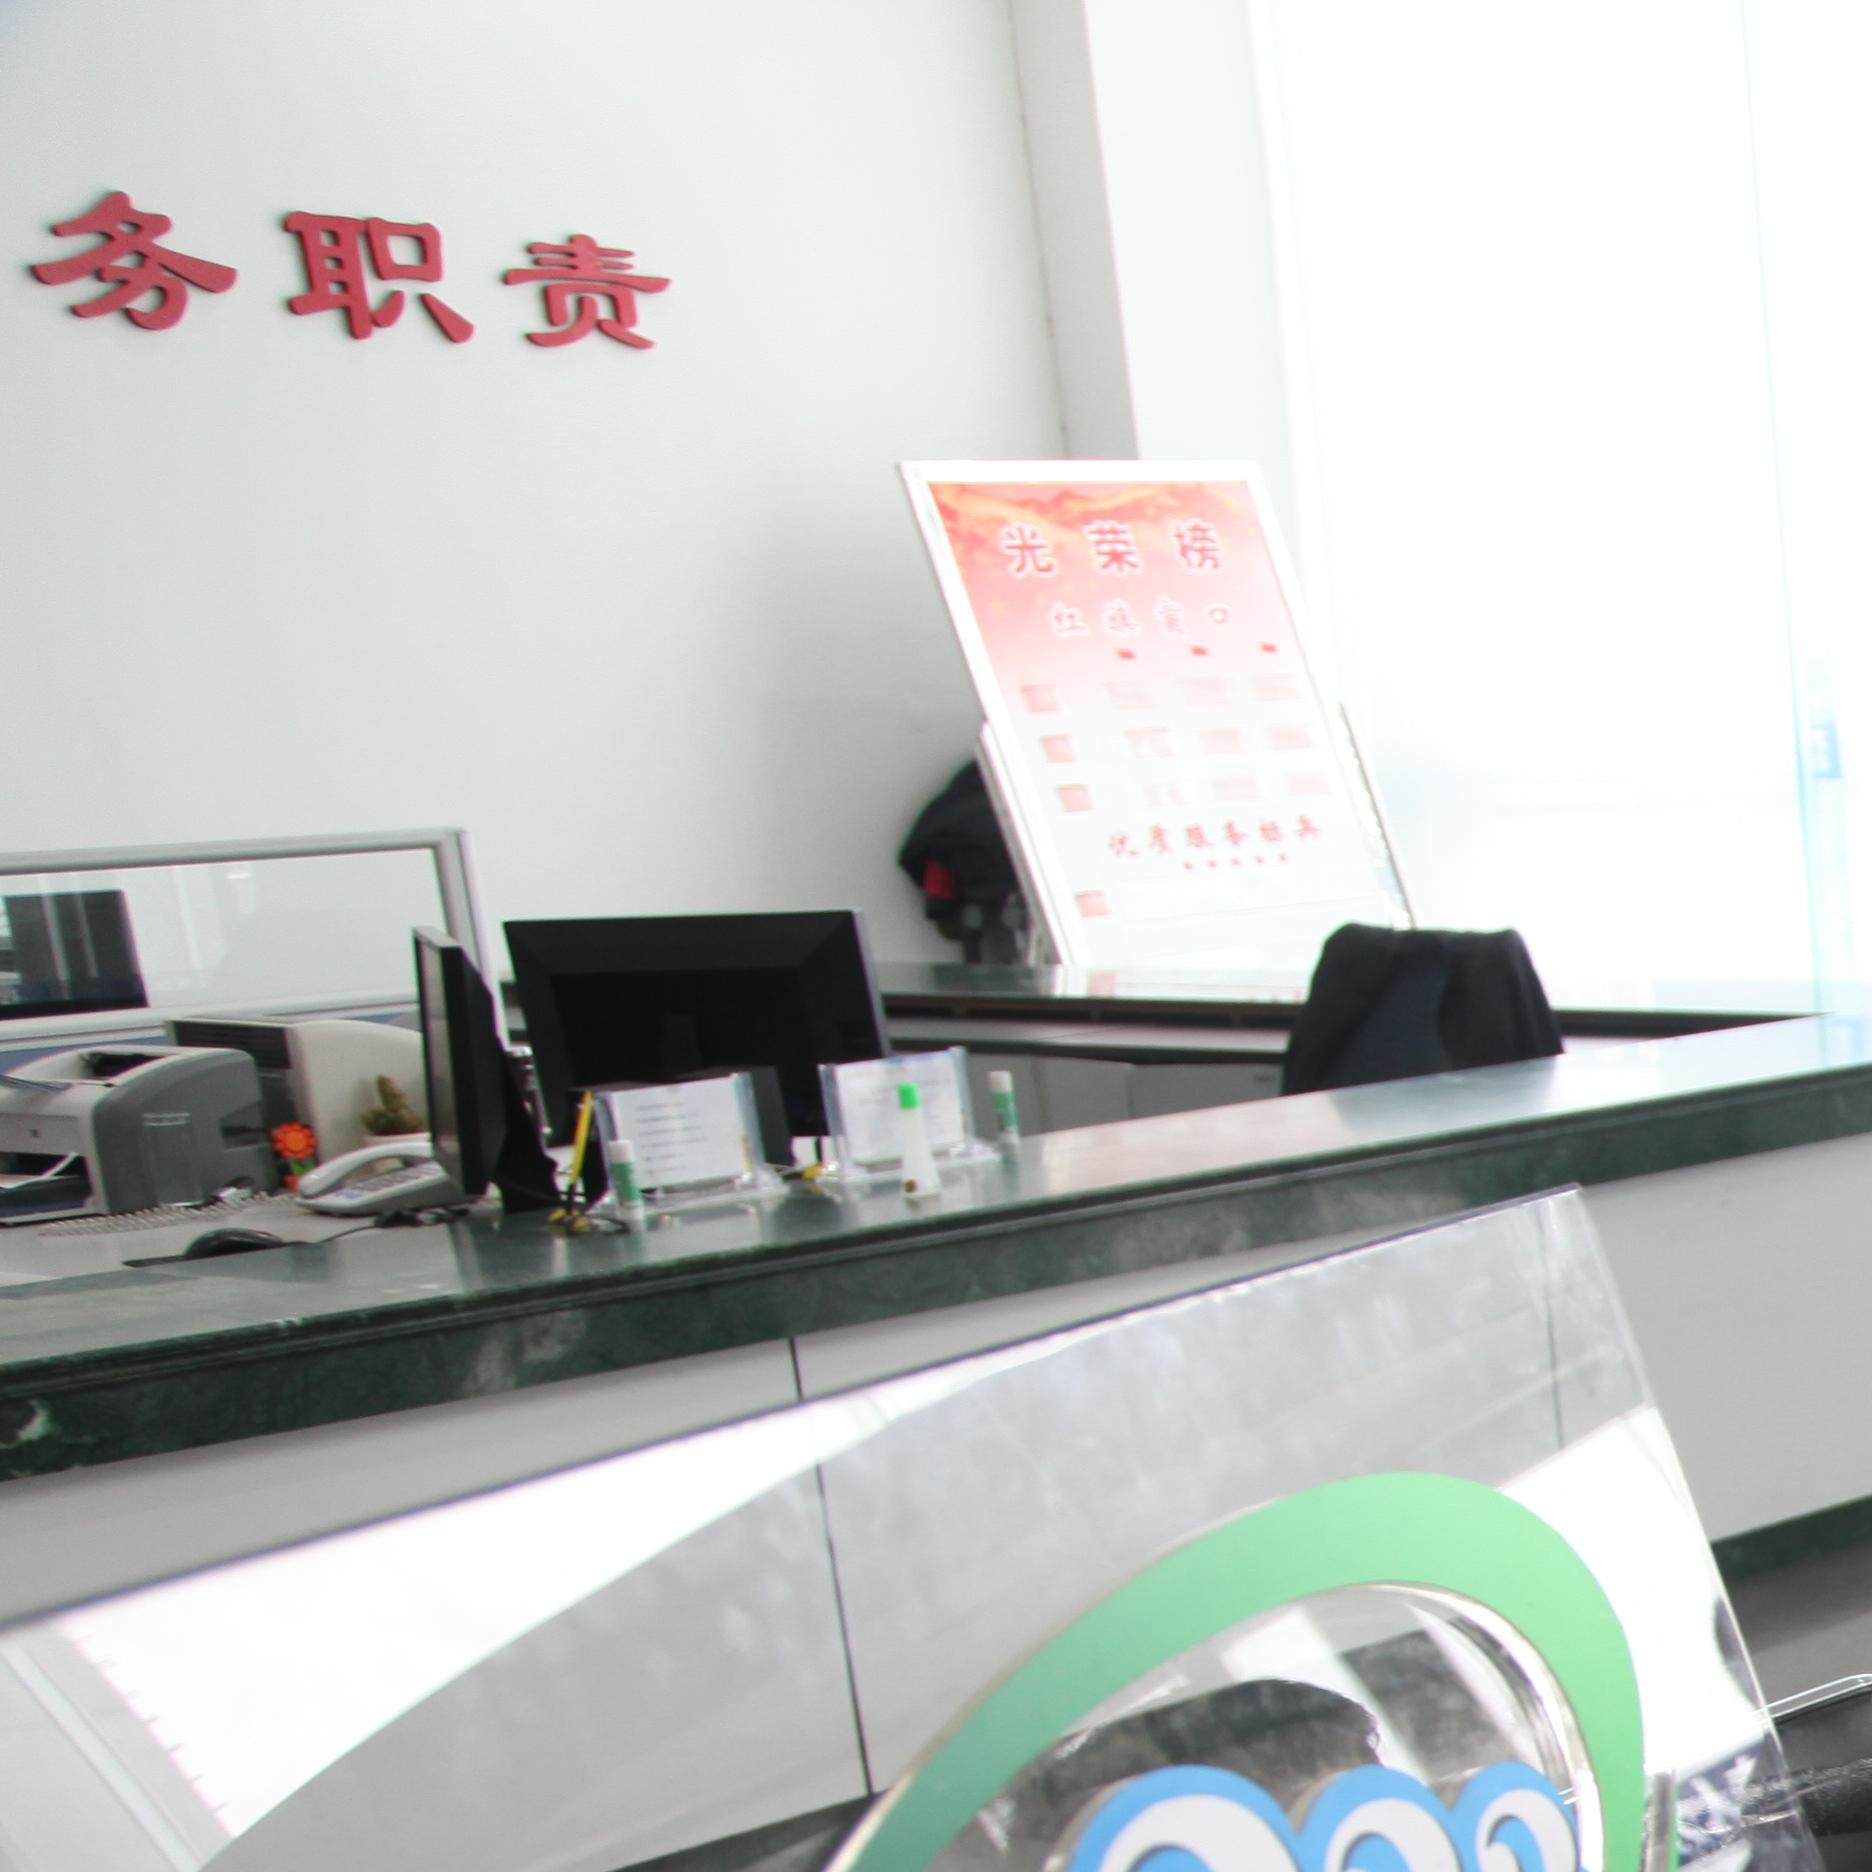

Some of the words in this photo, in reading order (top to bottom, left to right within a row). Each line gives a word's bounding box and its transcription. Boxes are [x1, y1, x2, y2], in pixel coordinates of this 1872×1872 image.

[30, 190, 672, 350] 务职责
[1002, 522, 1222, 574] 光荣榜
